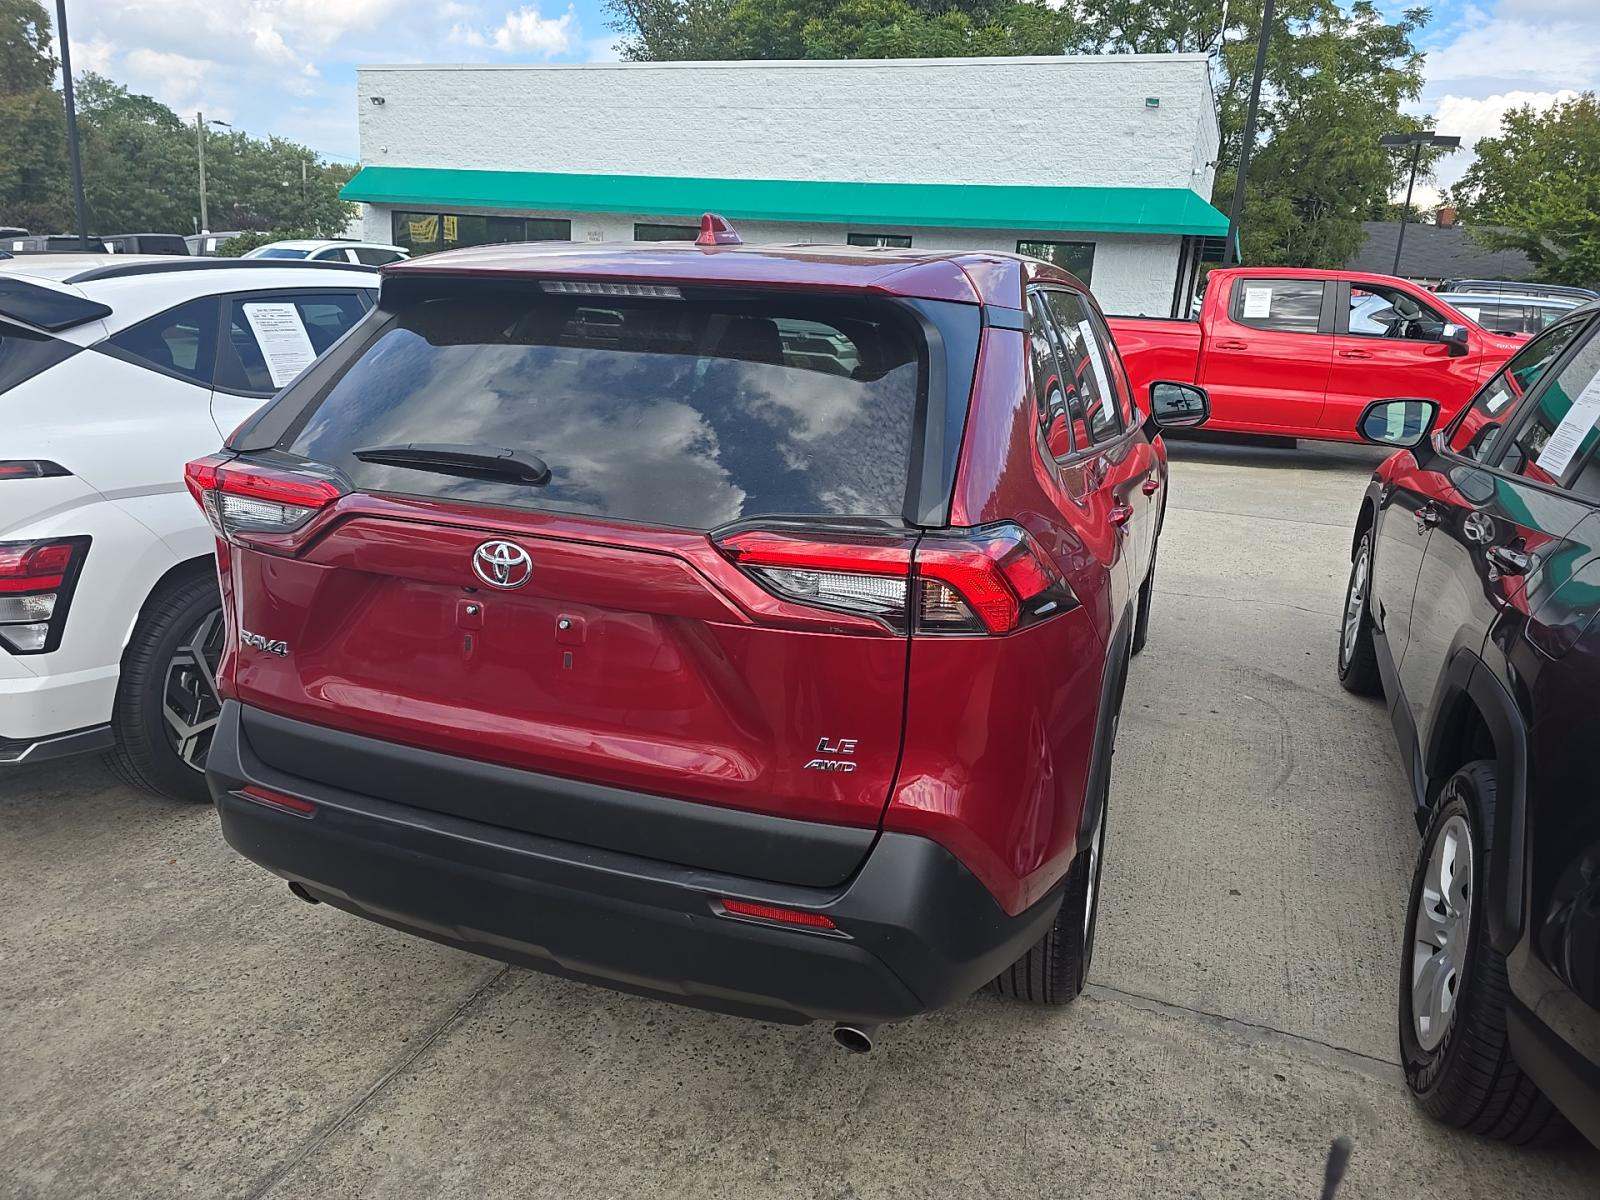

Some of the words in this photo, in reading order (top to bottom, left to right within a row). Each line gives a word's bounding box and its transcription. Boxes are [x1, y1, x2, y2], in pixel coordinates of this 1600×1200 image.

[240, 629, 288, 657] RAV4
[815, 736, 858, 754] LE
[803, 758, 857, 772] AWD
